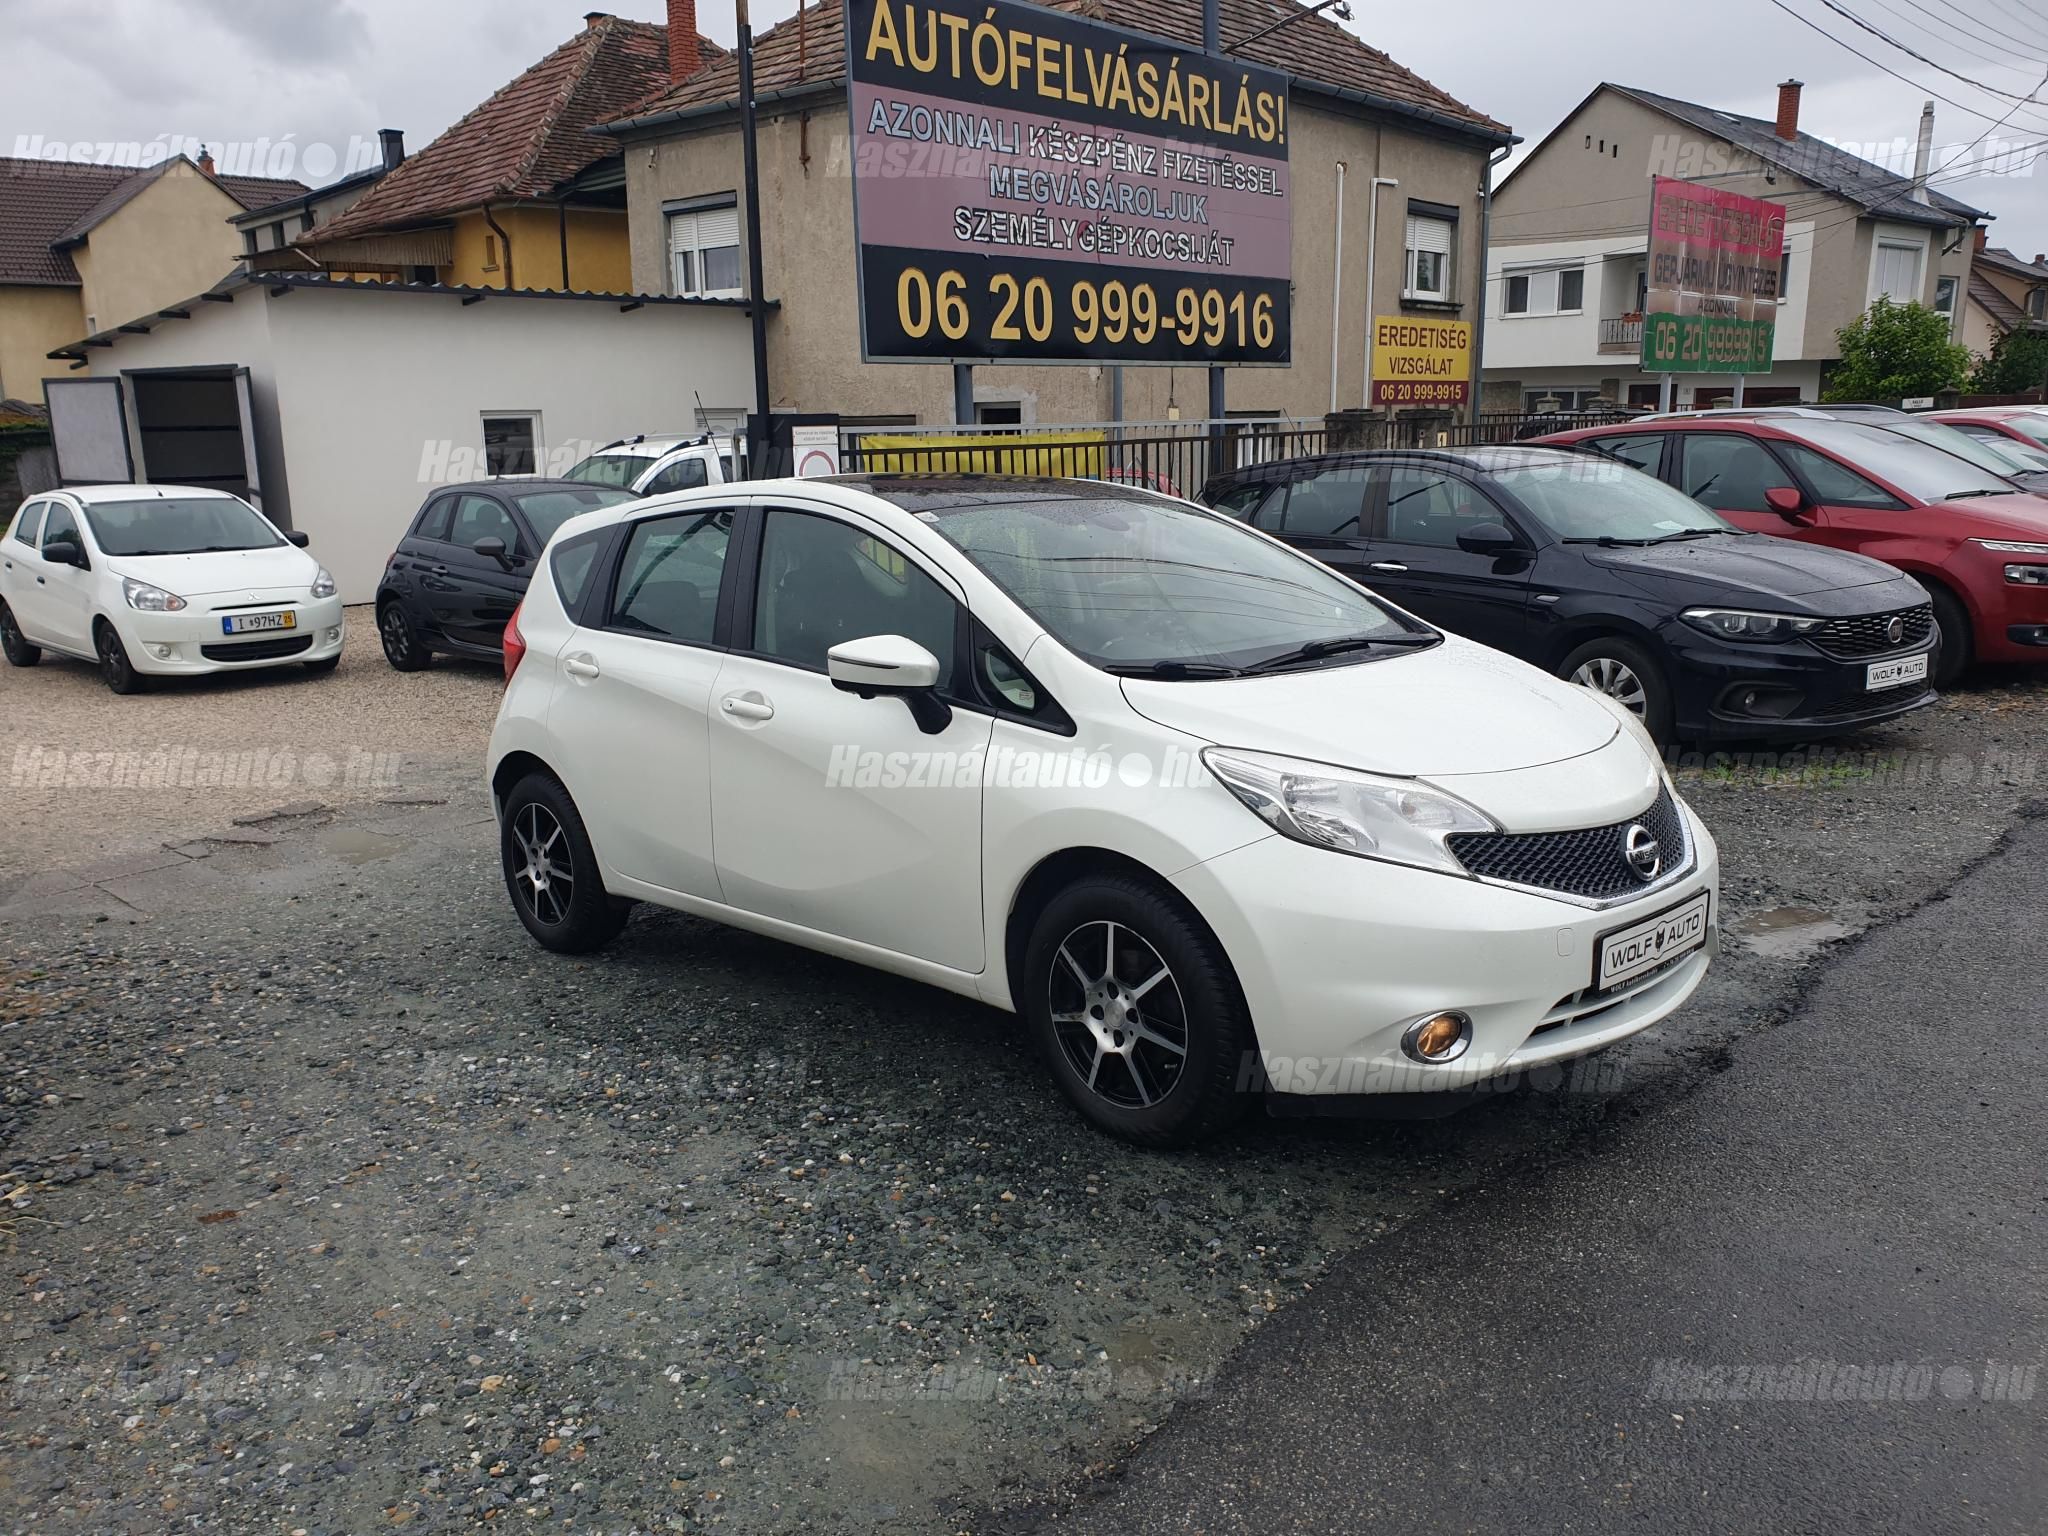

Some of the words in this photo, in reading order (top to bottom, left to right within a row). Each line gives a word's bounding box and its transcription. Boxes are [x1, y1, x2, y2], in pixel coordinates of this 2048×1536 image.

[865, 0, 1285, 145] AUTÓFELVÁSÁRLÁS!
[867, 98, 1021, 155] AZONNALI
[1028, 121, 1158, 178] KÉSZPÉNZ
[1162, 147, 1284, 198] FIZETÉSSEL
[989, 164, 1208, 225] MEGVÁSÁROLJUK
[897, 266, 969, 340] 06
[989, 273, 1053, 342] 20
[1071, 280, 1274, 349] 999-9916
[1378, 324, 1467, 349] EREDETISÉG
[1656, 321, 1676, 360] 06
[1681, 323, 1700, 361] 20
[1389, 354, 1453, 375] VIZSGÁLAT
[1381, 384, 1394, 400] 06
[1398, 384, 1410, 400] 20
[1414, 384, 1461, 400] 999-9915
[1872, 668, 1895, 680] WOLF
[1903, 662, 1924, 674] AUTO
[1611, 936, 1652, 969] WOLF
[1666, 912, 1700, 945] AUTO
